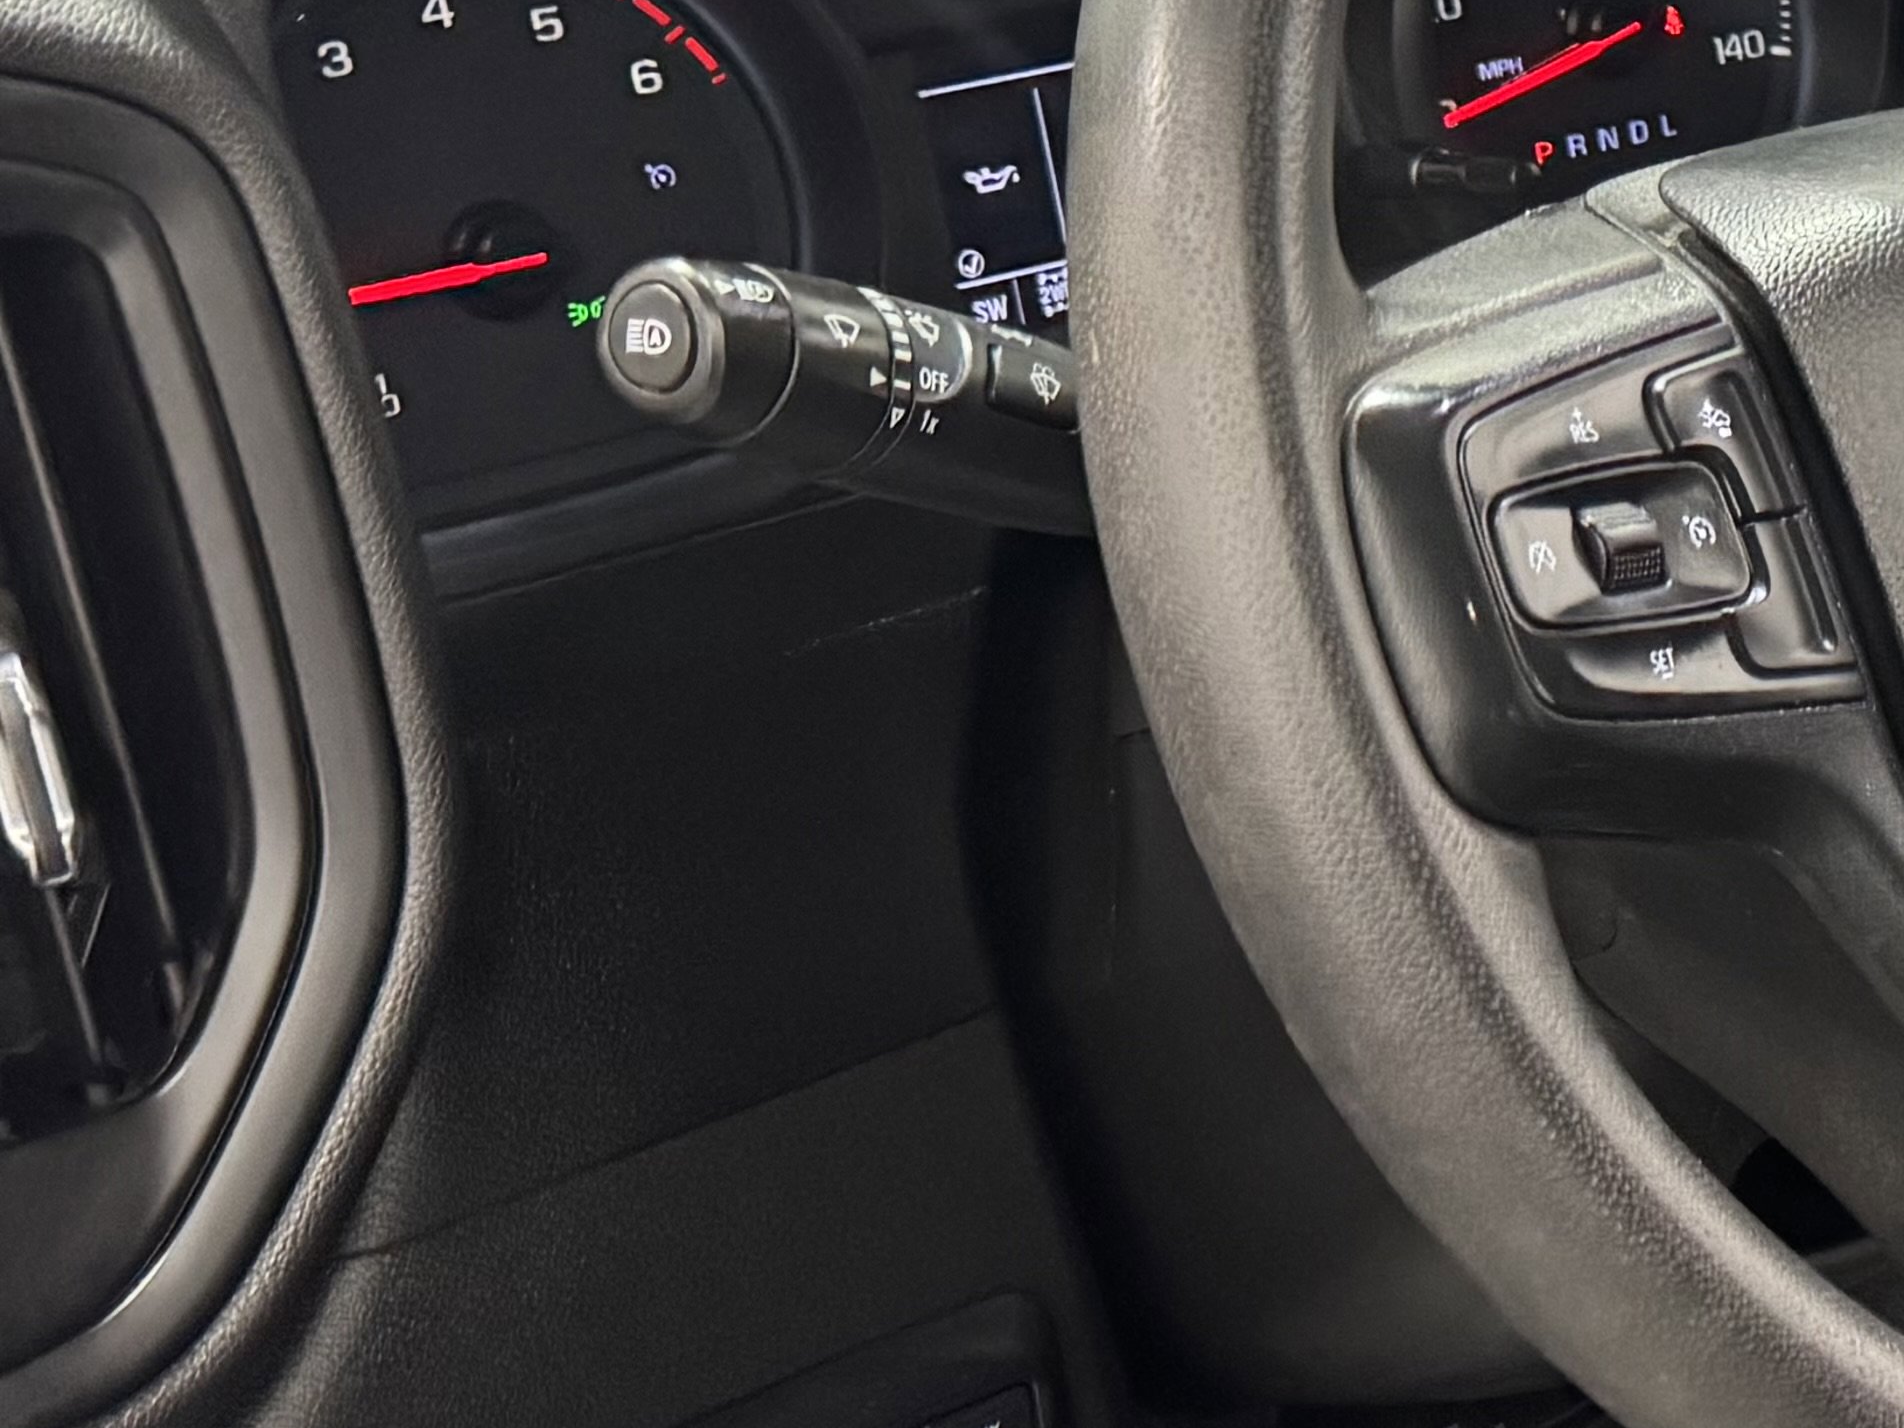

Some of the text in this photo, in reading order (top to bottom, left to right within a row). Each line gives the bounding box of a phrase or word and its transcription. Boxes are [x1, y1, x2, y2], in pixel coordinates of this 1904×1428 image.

[529, 4, 565, 42] 5
[316, 39, 354, 78] 3
[1713, 31, 1766, 66] 140
[630, 58, 664, 95] 6
[1476, 55, 1524, 82] MPH
[971, 293, 1008, 323] SW
[918, 366, 949, 394] OFF
[1650, 647, 1676, 672] SET
